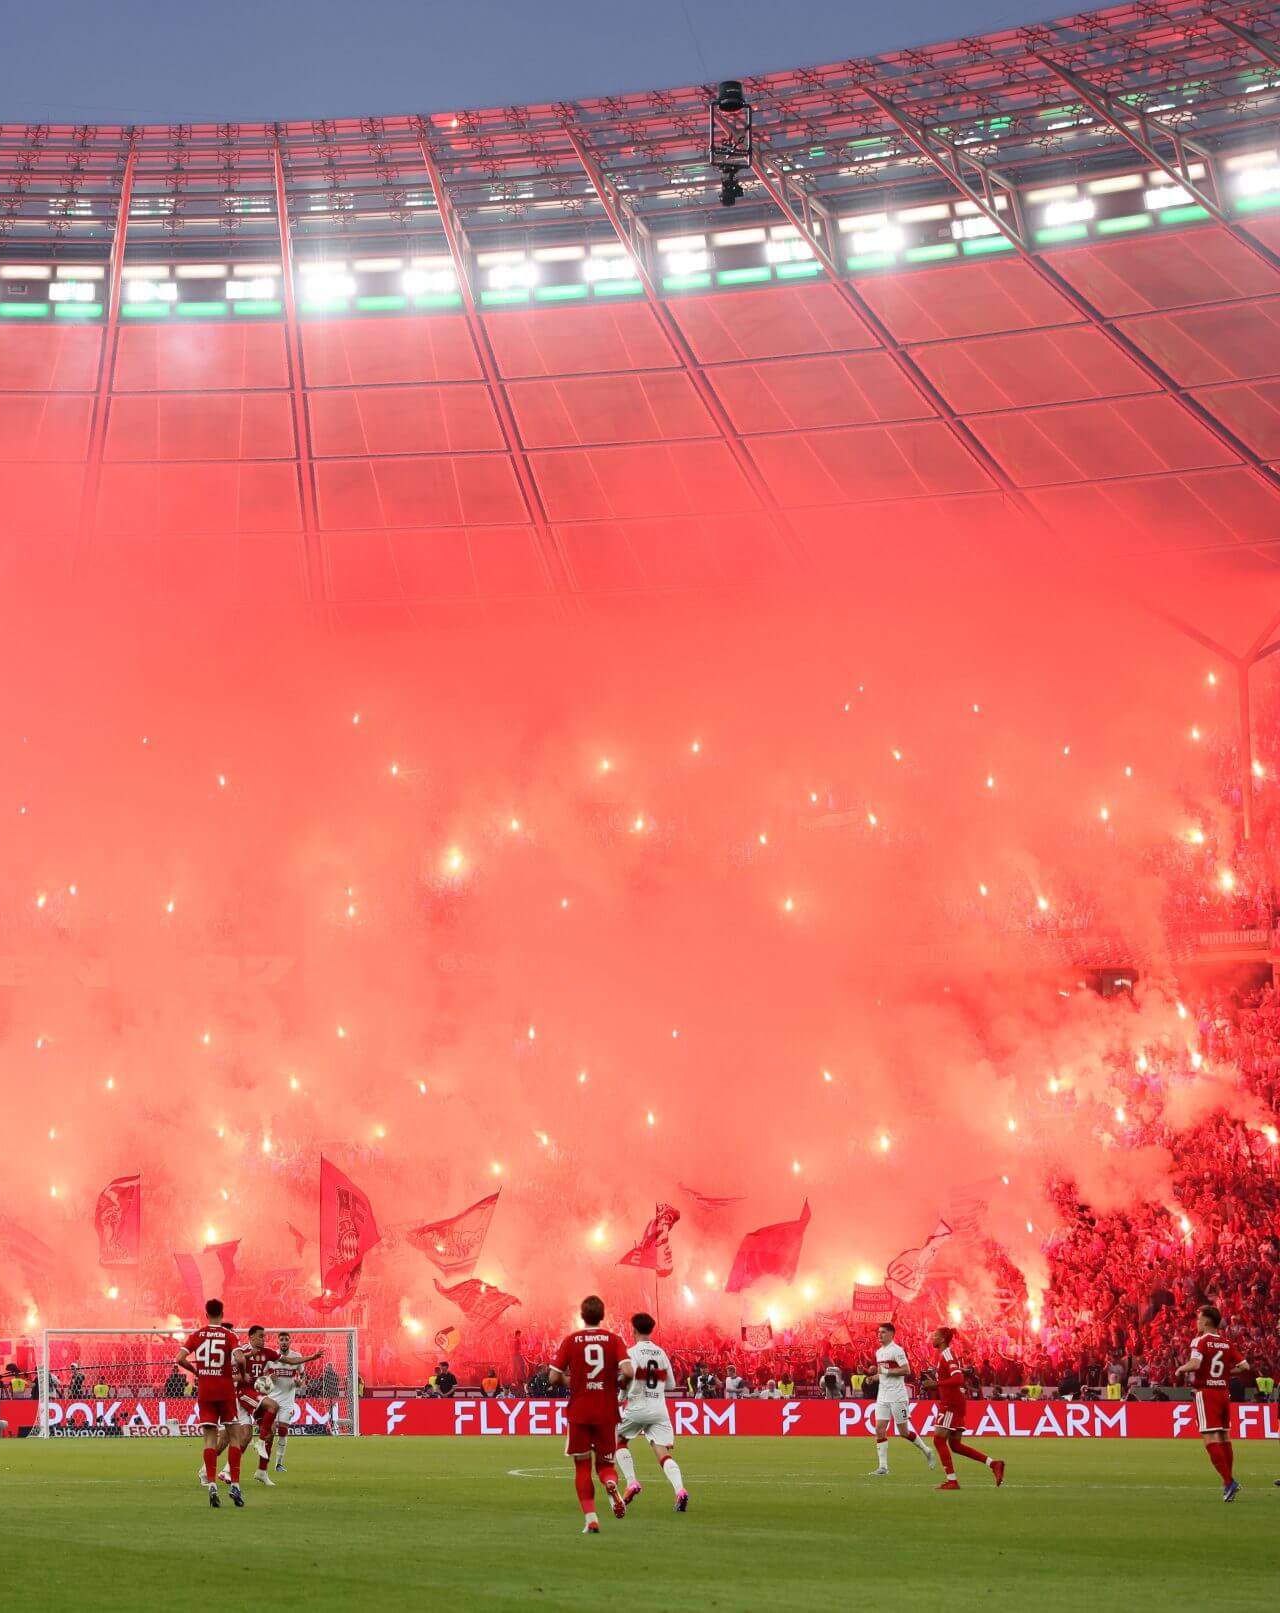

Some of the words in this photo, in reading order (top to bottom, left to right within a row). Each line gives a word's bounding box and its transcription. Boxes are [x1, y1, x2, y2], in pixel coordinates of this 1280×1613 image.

[574, 1335, 583, 1343] FC
[195, 1339, 226, 1368] 45
[584, 1344, 605, 1379] 9
[1209, 1350, 1224, 1377] 6
[586, 1381, 604, 1390] KANE
[901, 1409, 907, 1418] 3
[937, 1413, 944, 1424] 7
[129, 1426, 170, 1436] ERGO
